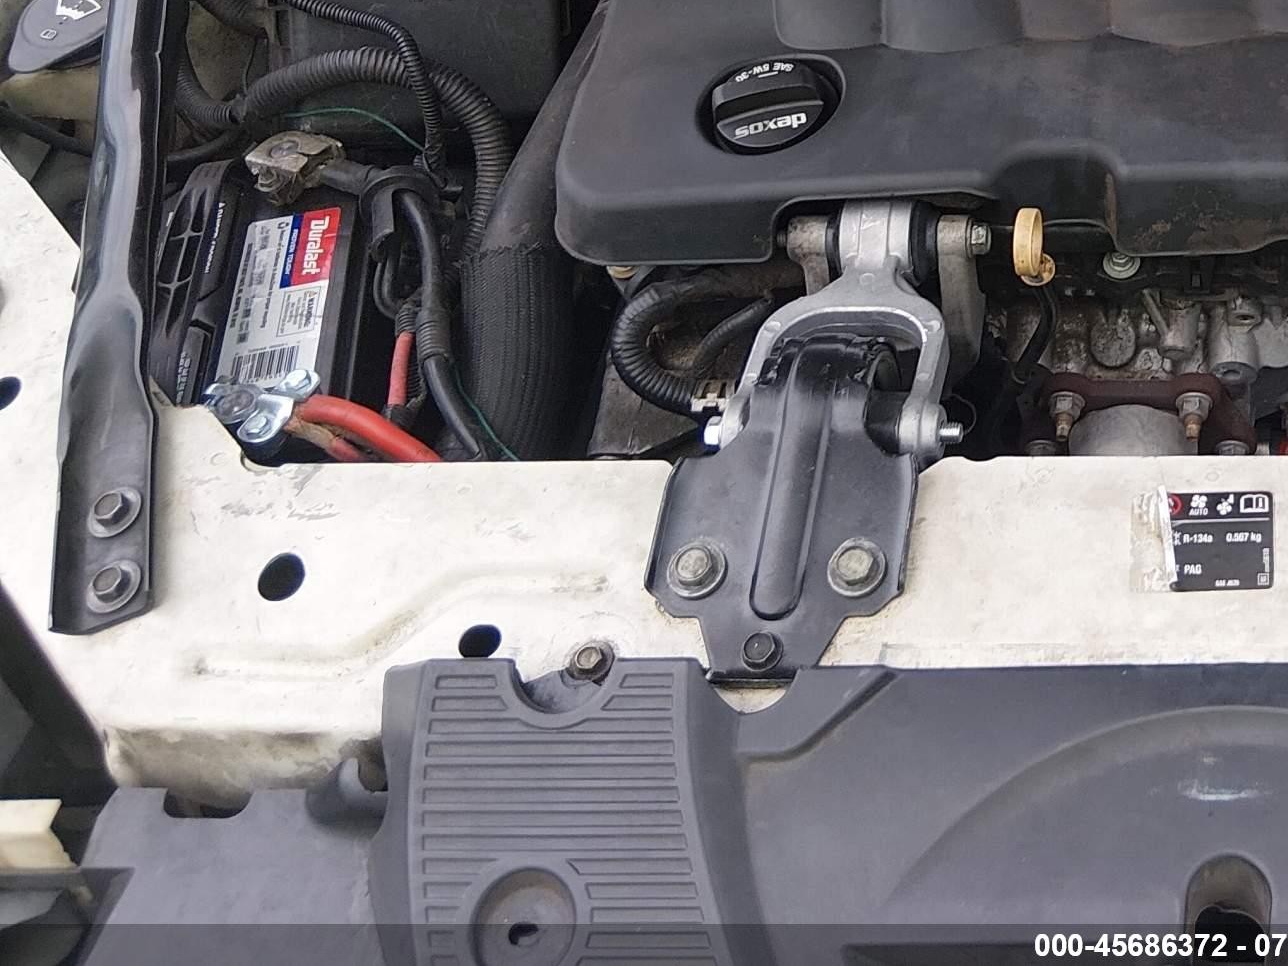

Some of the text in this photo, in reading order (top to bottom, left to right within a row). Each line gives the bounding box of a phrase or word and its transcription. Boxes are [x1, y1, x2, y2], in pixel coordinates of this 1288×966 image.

[735, 62, 794, 82] SAE 5W-30
[733, 112, 807, 140] dexos
[284, 228, 299, 275] PROVEN TOUGH
[302, 216, 330, 276] Duralast
[1188, 508, 1209, 516] AUTO
[1182, 533, 1213, 544] R-134a
[1250, 531, 1262, 544] kg
[1183, 564, 1202, 575] PAG
